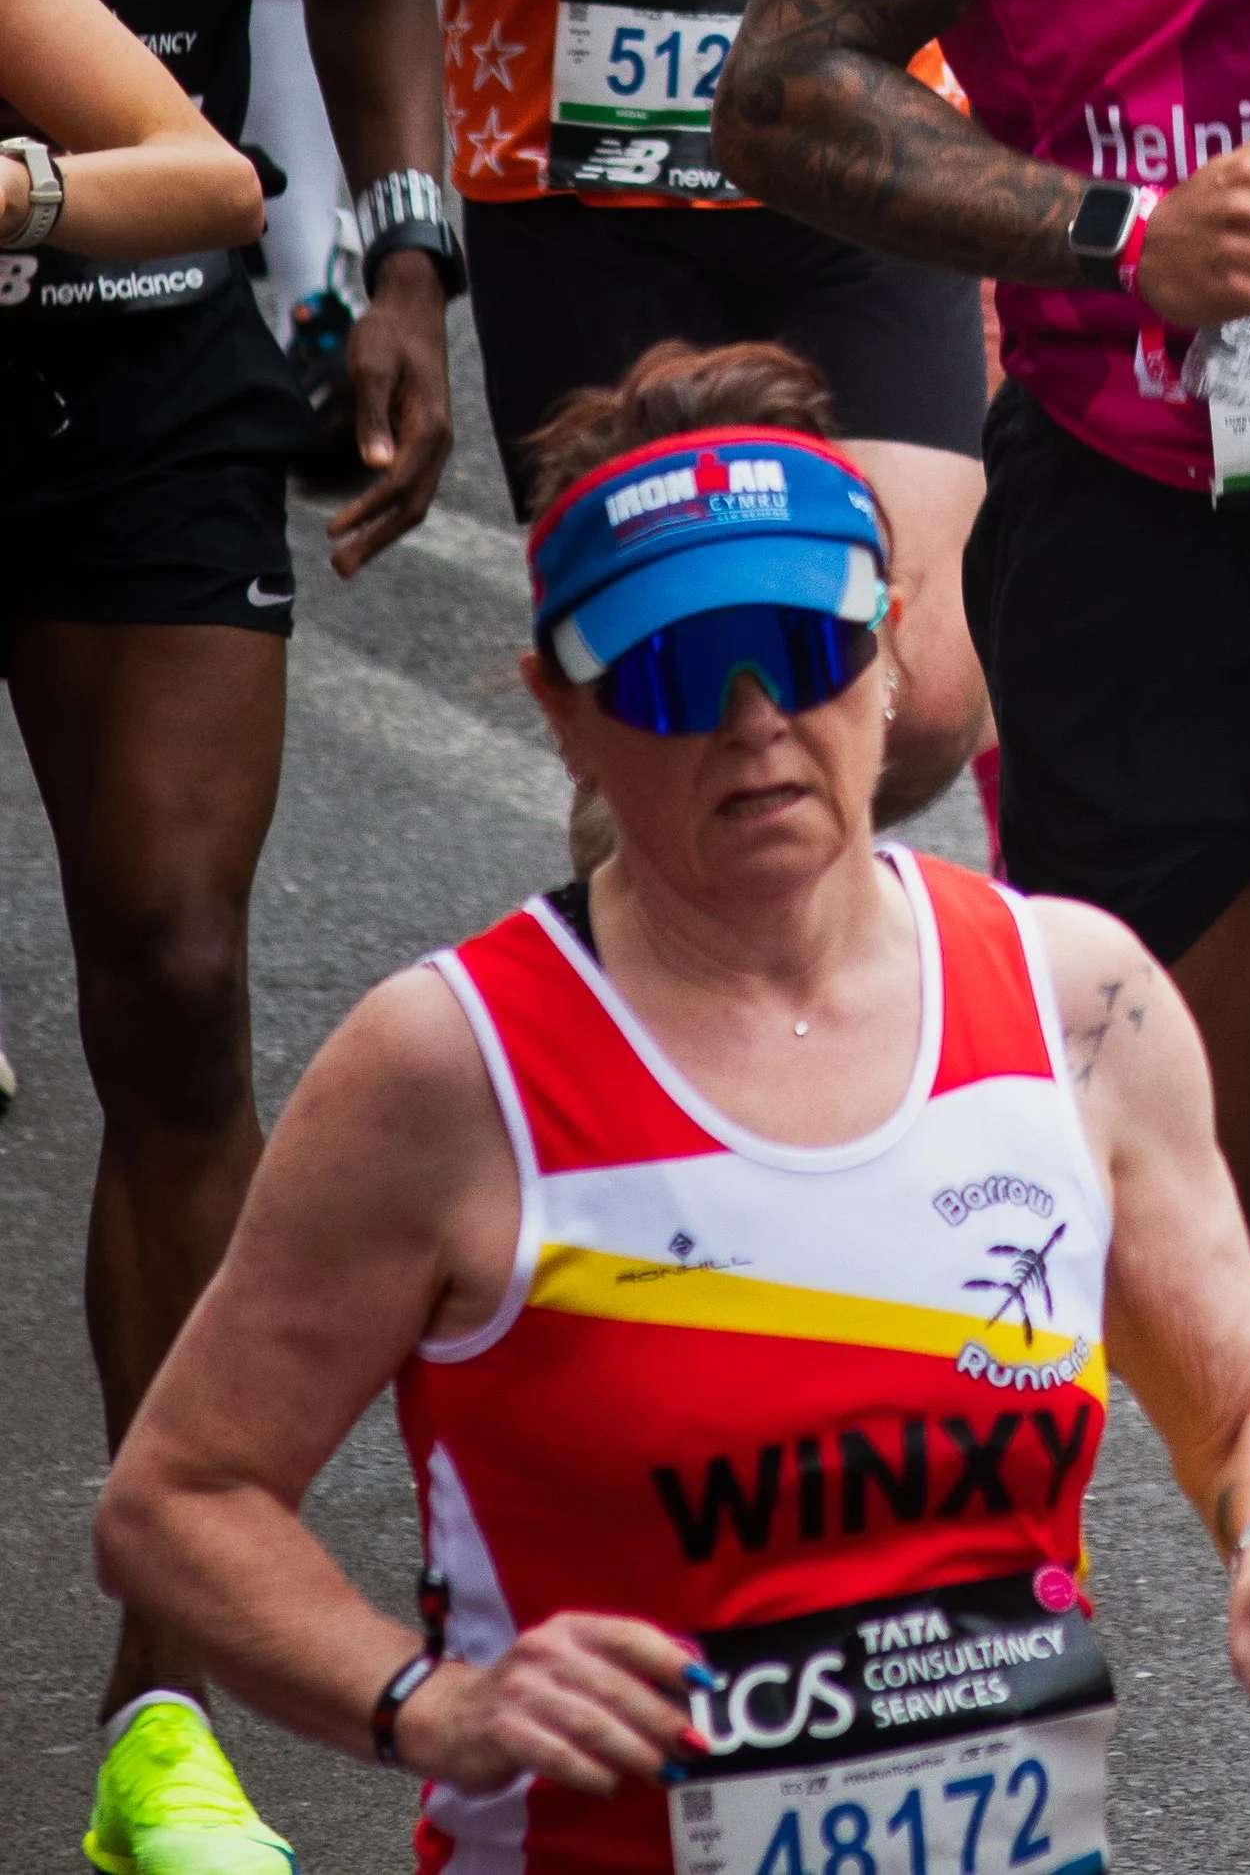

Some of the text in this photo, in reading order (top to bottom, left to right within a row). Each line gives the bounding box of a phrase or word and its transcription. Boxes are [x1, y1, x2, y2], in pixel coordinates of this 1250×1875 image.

[669, 167, 721, 188] new
[41, 266, 204, 307] new balance
[708, 492, 788, 512] CYMRU
[932, 1174, 1055, 1227] Barrow
[955, 1333, 1089, 1392] Runners
[858, 1608, 952, 1657] TATA
[862, 1624, 1066, 1692] CONSULTANCY
[869, 1677, 1012, 1729] SERVICES
[753, 1757, 1054, 1875] 48172
